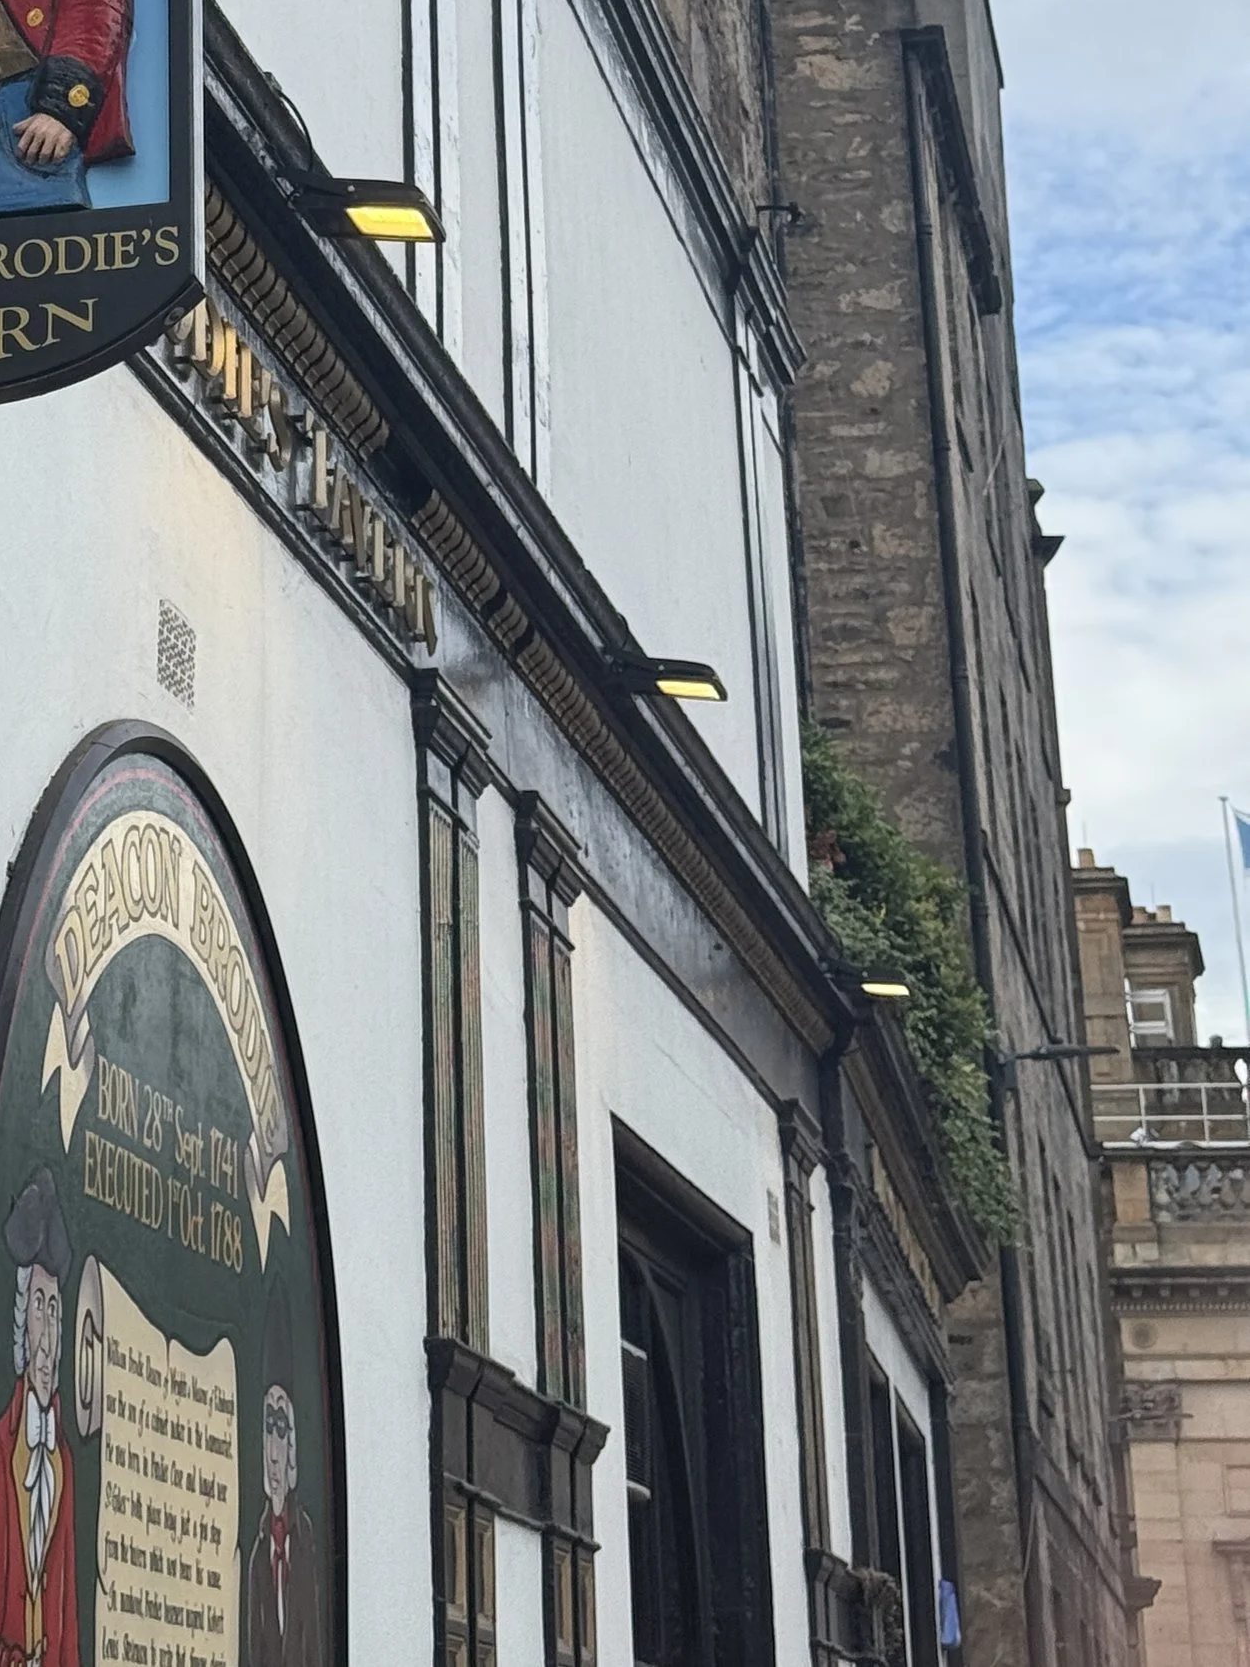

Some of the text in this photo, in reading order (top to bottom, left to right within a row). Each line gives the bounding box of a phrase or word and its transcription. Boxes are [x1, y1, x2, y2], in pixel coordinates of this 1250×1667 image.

[54, 823, 280, 1157] DEACON BRODIE
[98, 1054, 140, 1141] BORN
[143, 1085, 174, 1152] 28TH
[210, 1126, 238, 1200] 1741
[84, 1130, 164, 1230] EXECUTED
[210, 1201, 243, 1274] 1788
